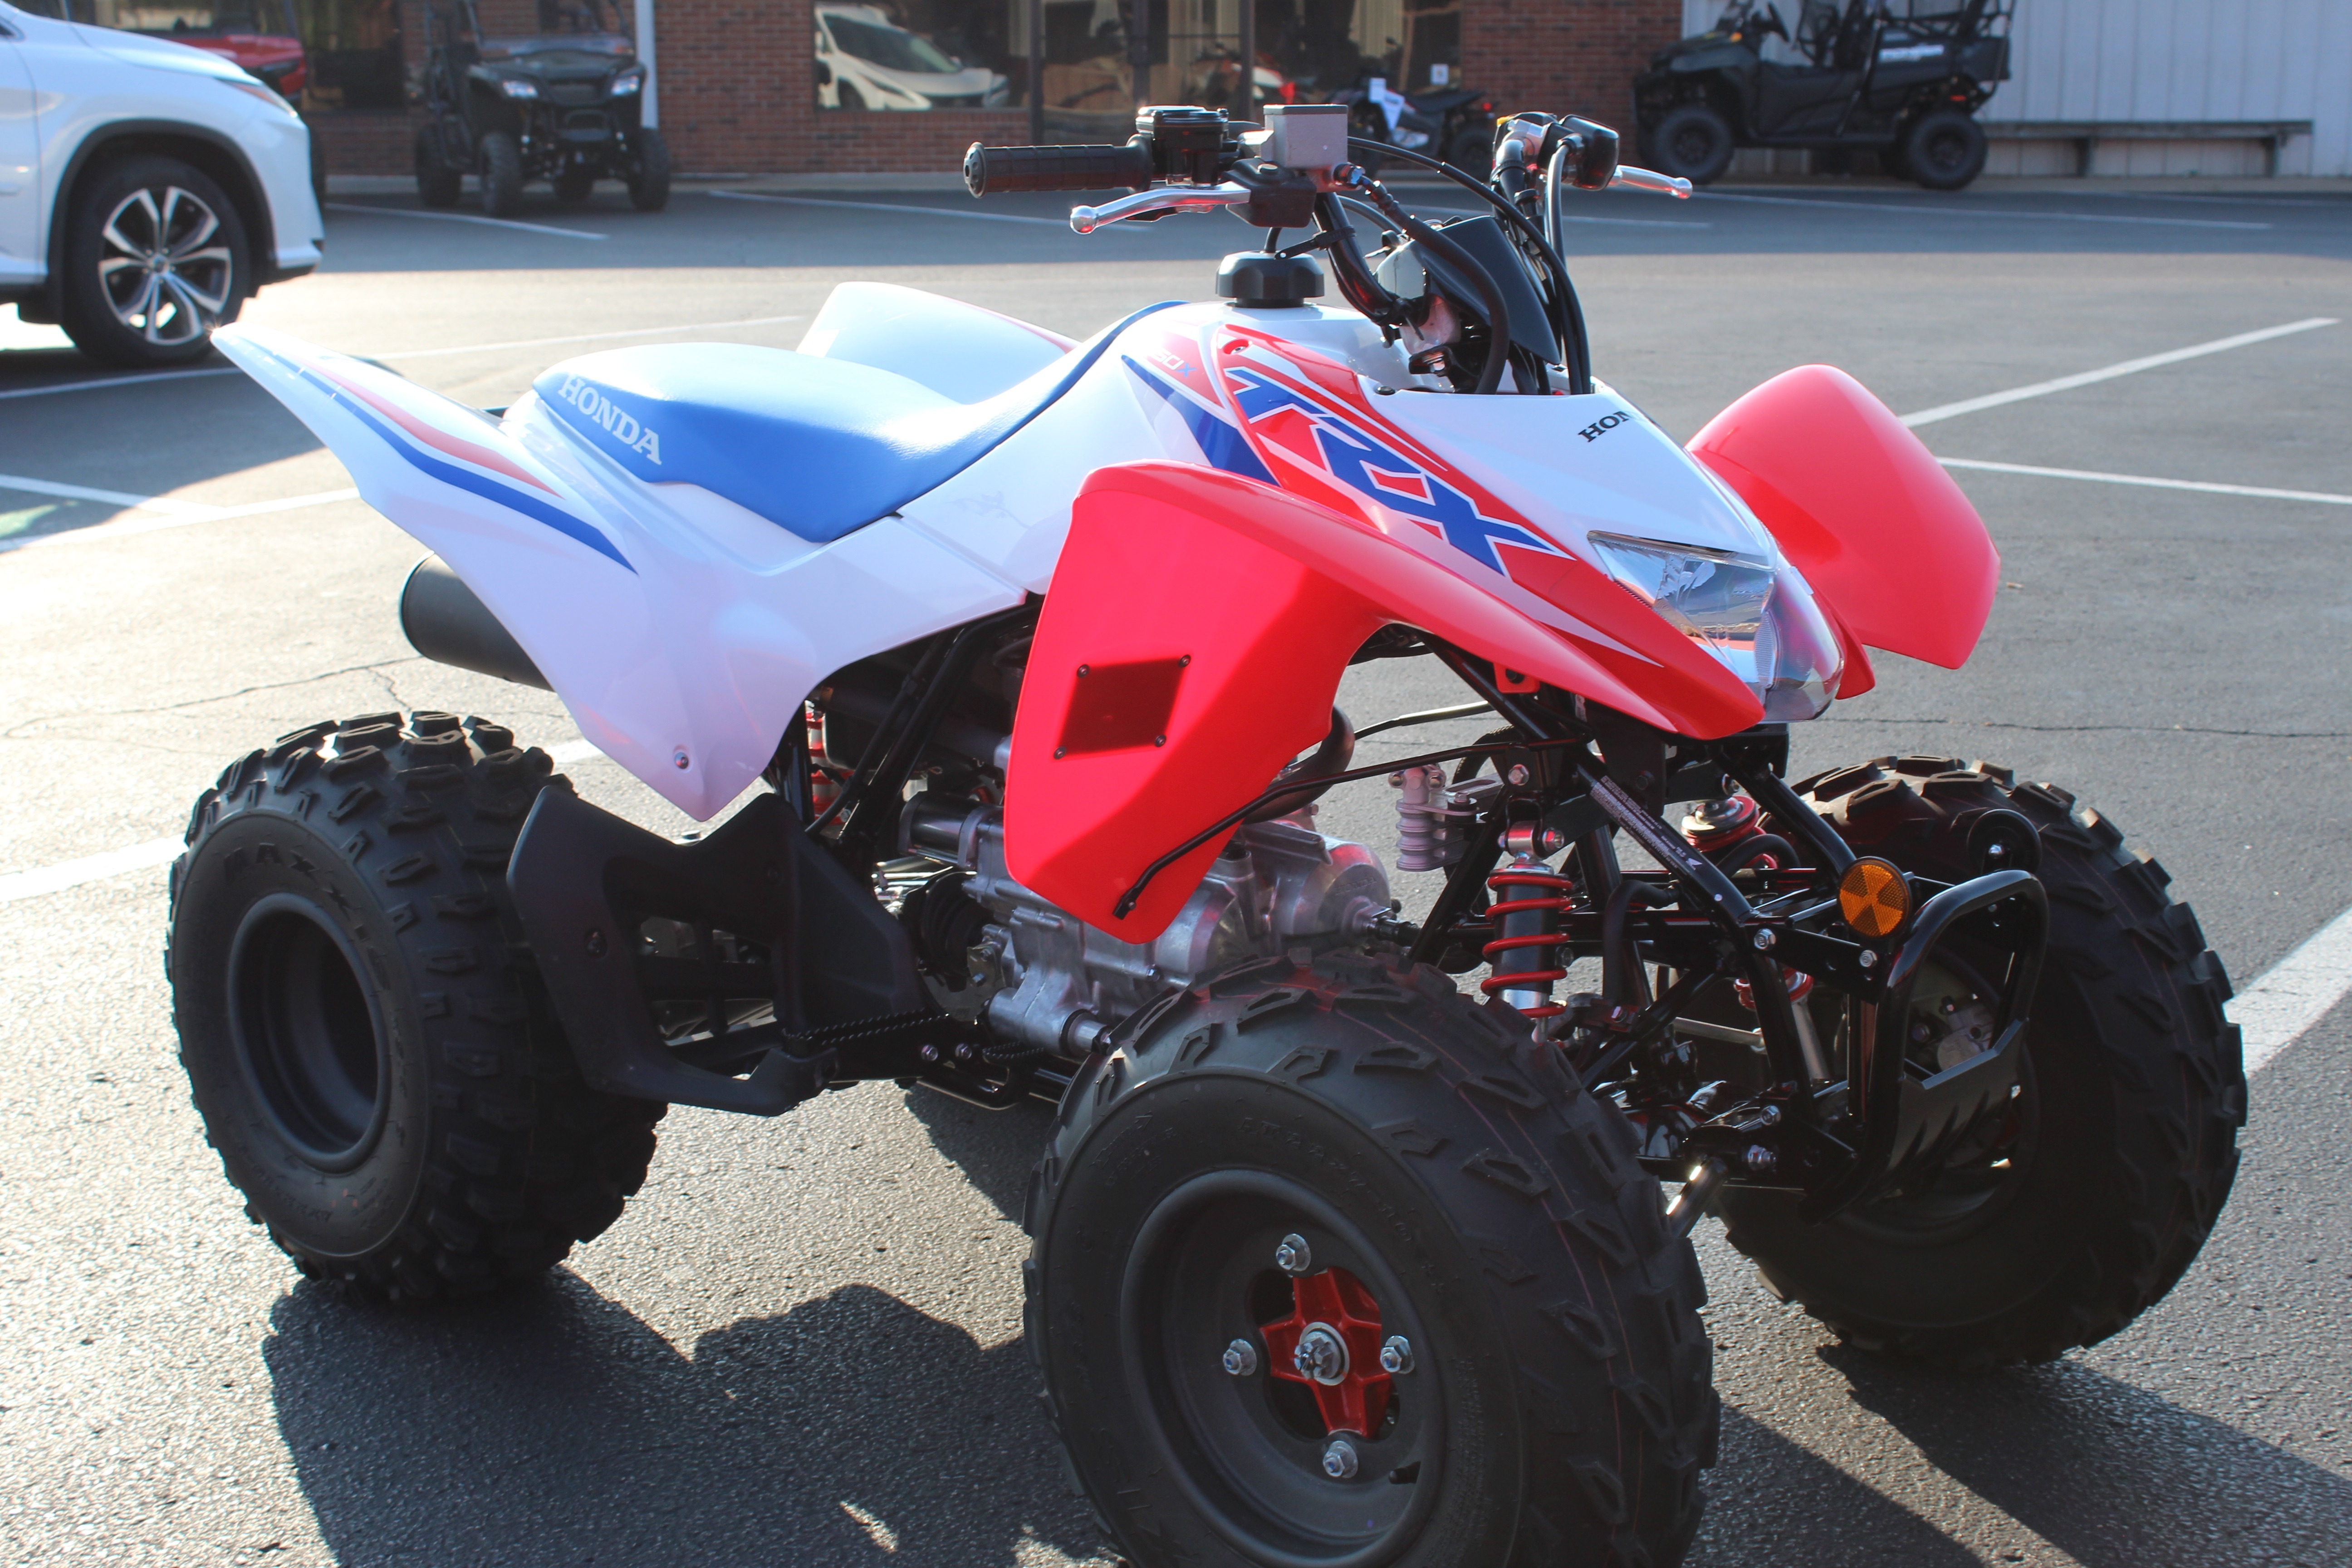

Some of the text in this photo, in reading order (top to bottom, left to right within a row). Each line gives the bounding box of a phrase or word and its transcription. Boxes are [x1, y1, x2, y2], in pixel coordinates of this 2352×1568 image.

[557, 372, 662, 465] HONDA
[1578, 411, 1634, 442] HON
[1225, 367, 1570, 578] TRX
